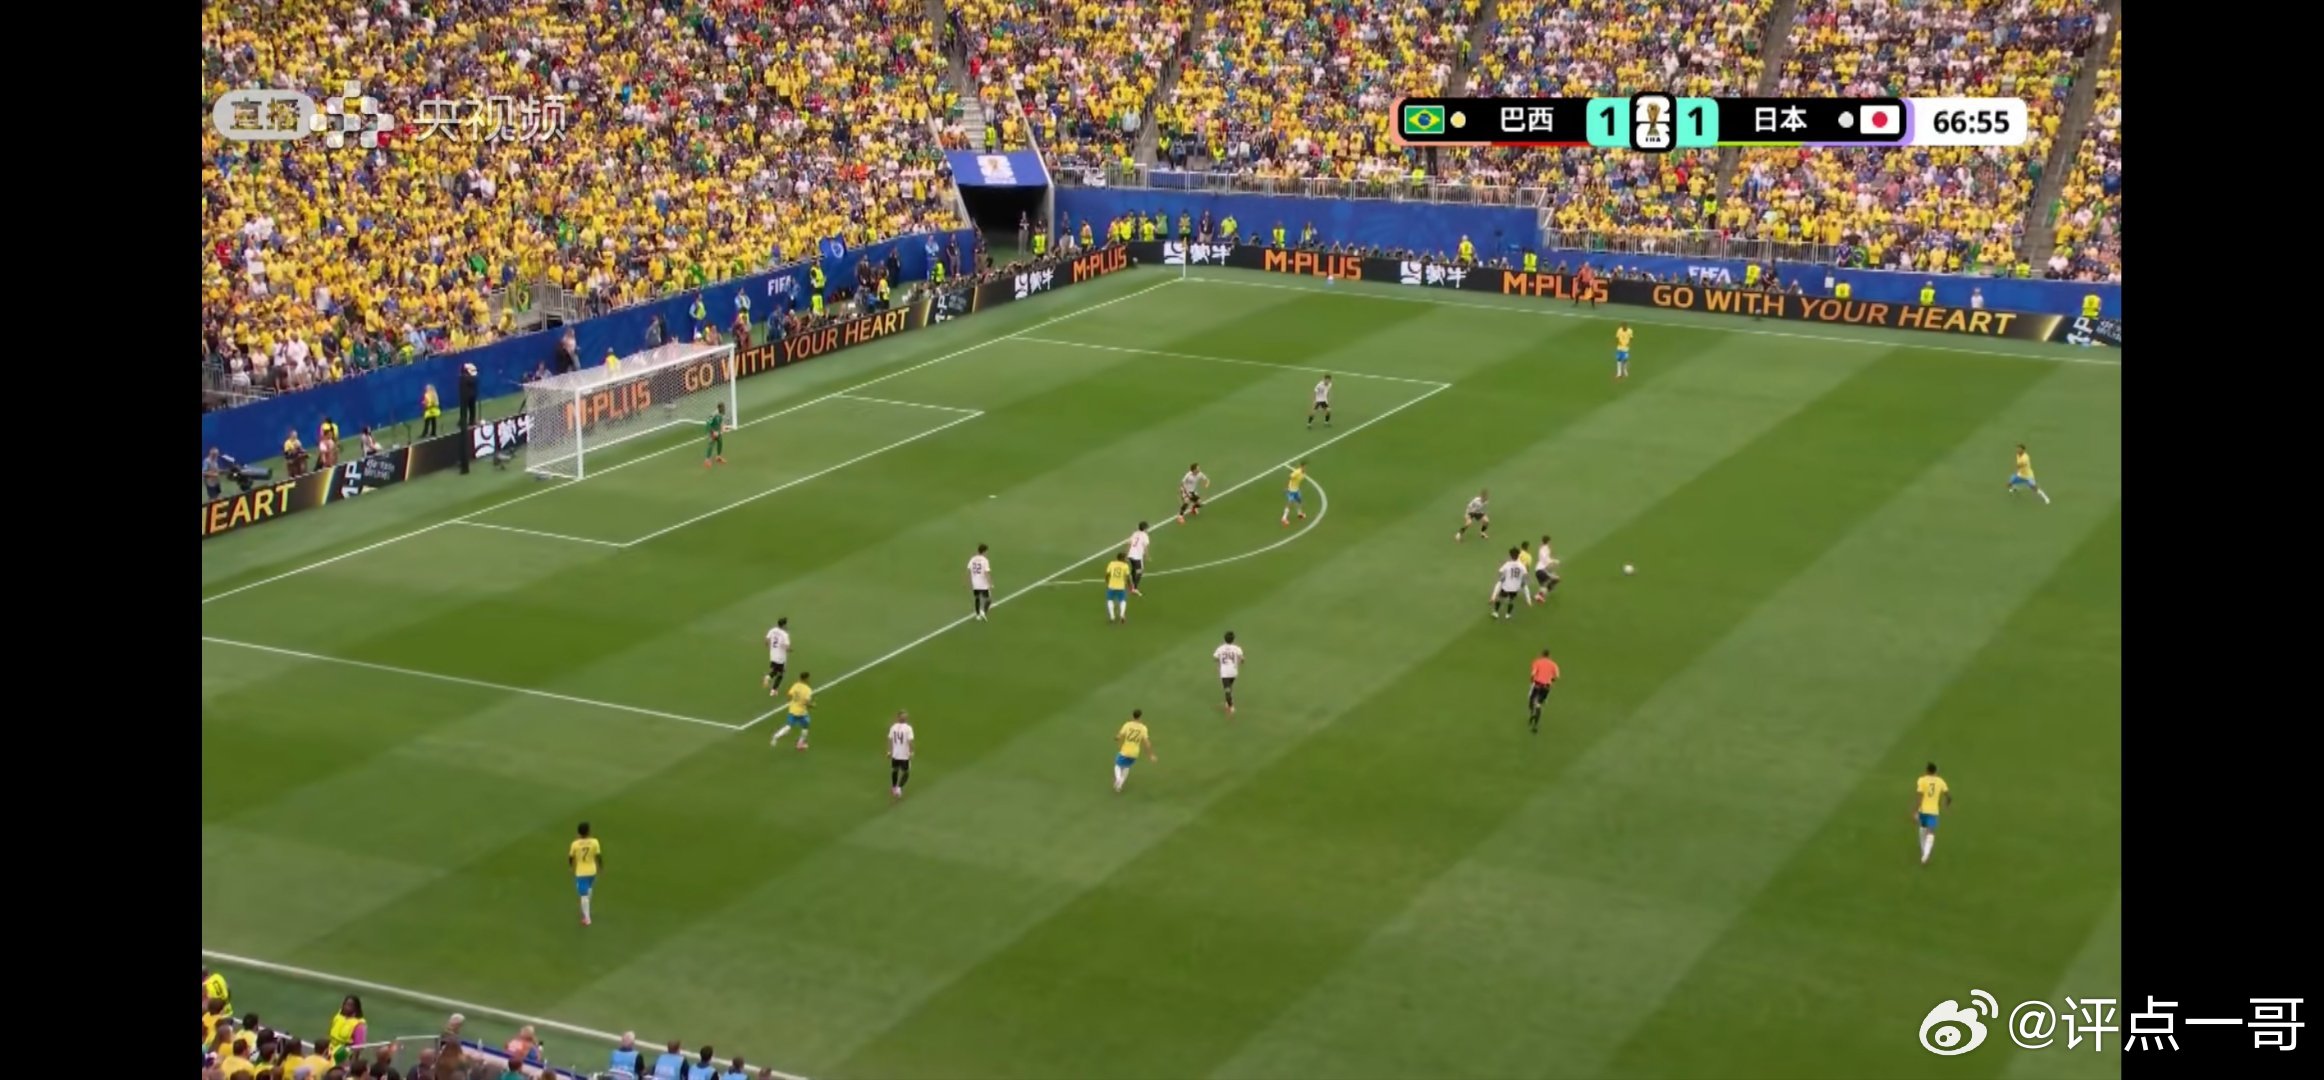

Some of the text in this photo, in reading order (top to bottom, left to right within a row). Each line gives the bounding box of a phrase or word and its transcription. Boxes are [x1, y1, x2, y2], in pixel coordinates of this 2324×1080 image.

[1073, 246, 1128, 283] M-PLUS
[1265, 249, 1362, 280] M-PLUS
[1653, 284, 2017, 335] GO WITH YOUR HEART
[685, 307, 910, 391] GO WITH YOUR HEART
[893, 731, 904, 744] 14
[1127, 728, 1141, 744] 22
[1928, 783, 1935, 797] 3
[582, 847, 590, 862] 7
